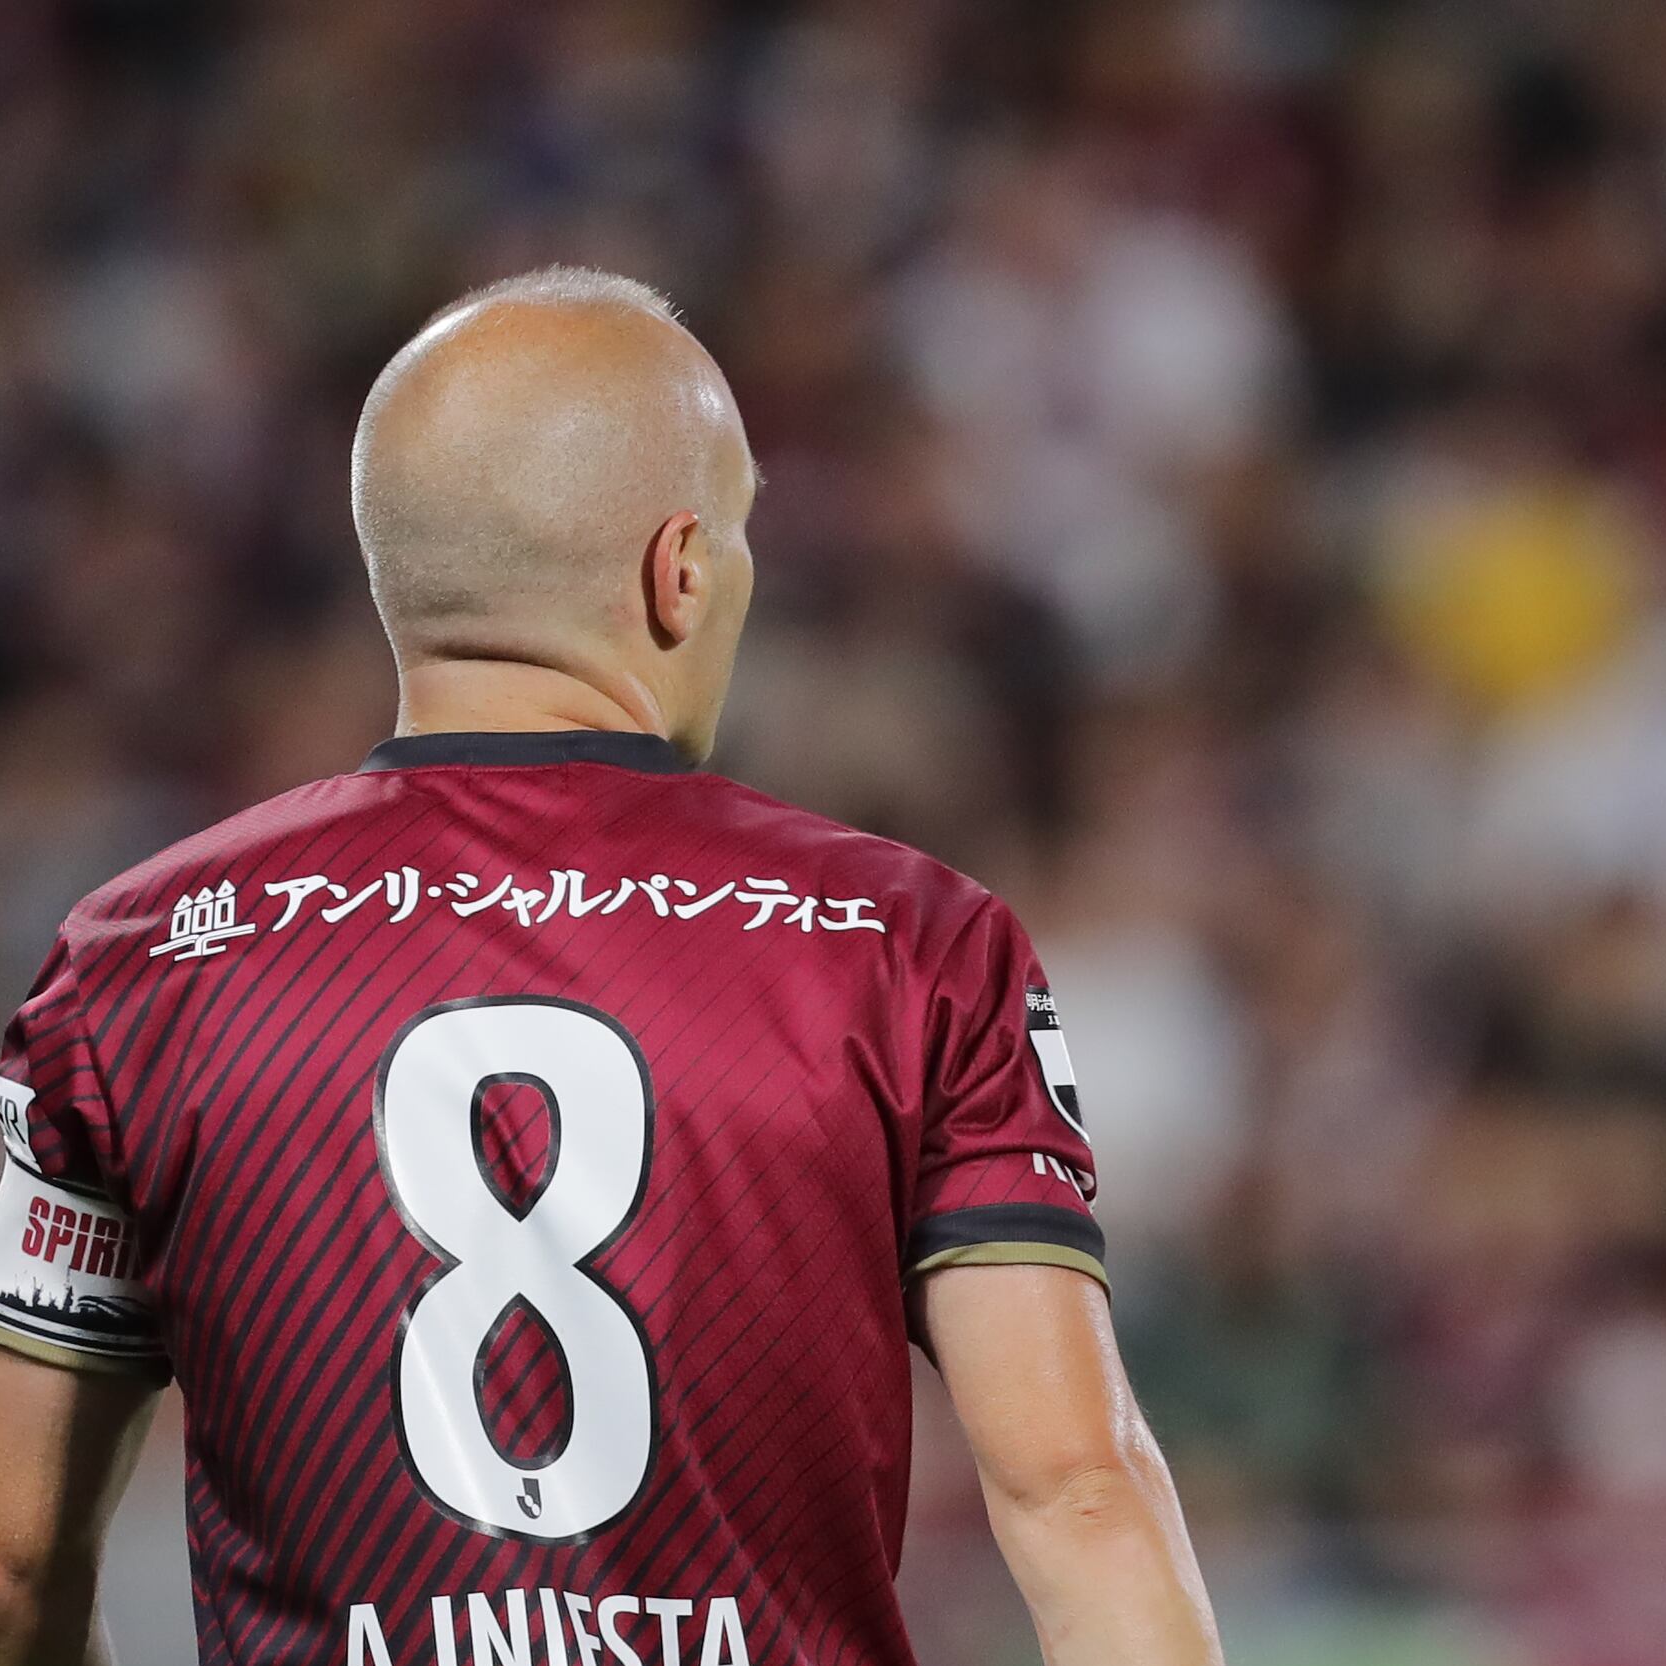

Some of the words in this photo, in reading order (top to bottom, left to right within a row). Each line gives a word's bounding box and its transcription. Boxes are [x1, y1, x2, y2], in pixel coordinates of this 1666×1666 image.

[265, 866, 887, 933] アンリ・シャルパンティエ
[375, 996, 659, 1544] 8
